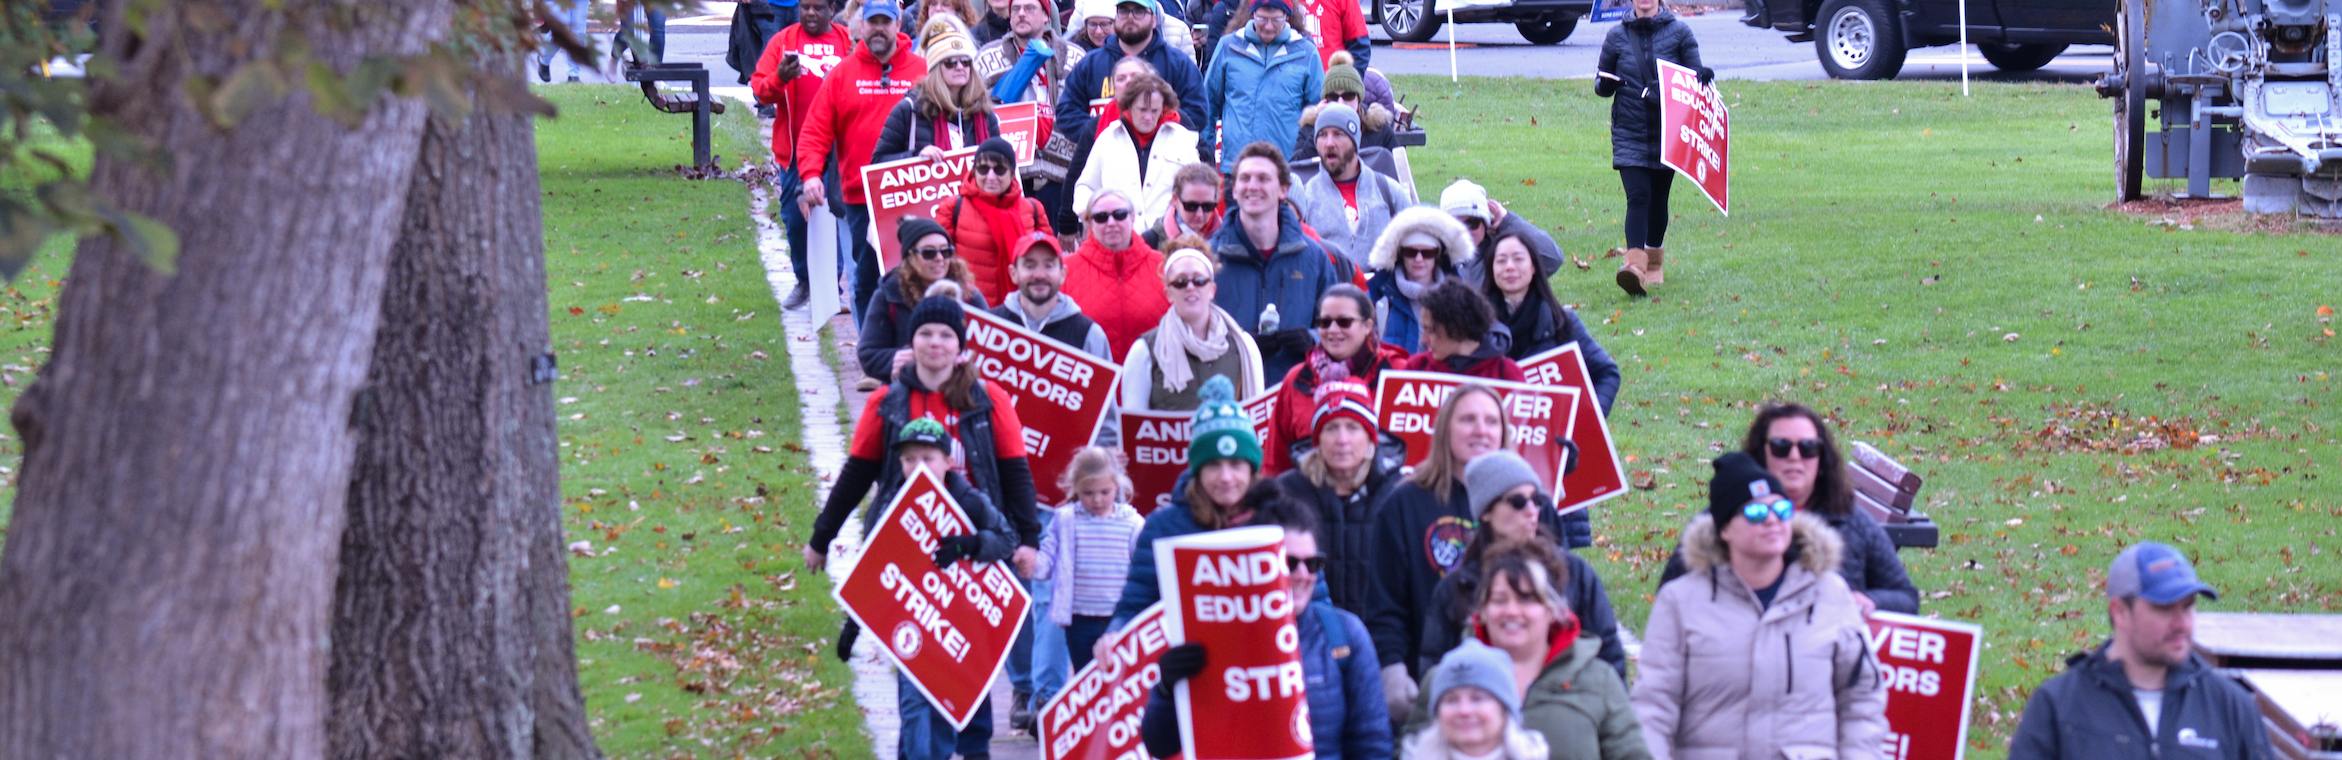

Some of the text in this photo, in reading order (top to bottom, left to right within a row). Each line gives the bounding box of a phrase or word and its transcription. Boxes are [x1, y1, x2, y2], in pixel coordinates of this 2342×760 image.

[901, 79, 912, 87] the
[1680, 125, 1720, 173] STRIKE!
[879, 154, 976, 190] ANDOVE
[880, 179, 963, 209] EDUCAT
[965, 318, 1095, 388] NDOVER
[922, 571, 955, 608] ON
[879, 562, 971, 663] STRIKE!
[1276, 624, 1299, 654] O
[1052, 617, 1167, 736] ANDOVE
[1053, 663, 1162, 760] EDUCATO
